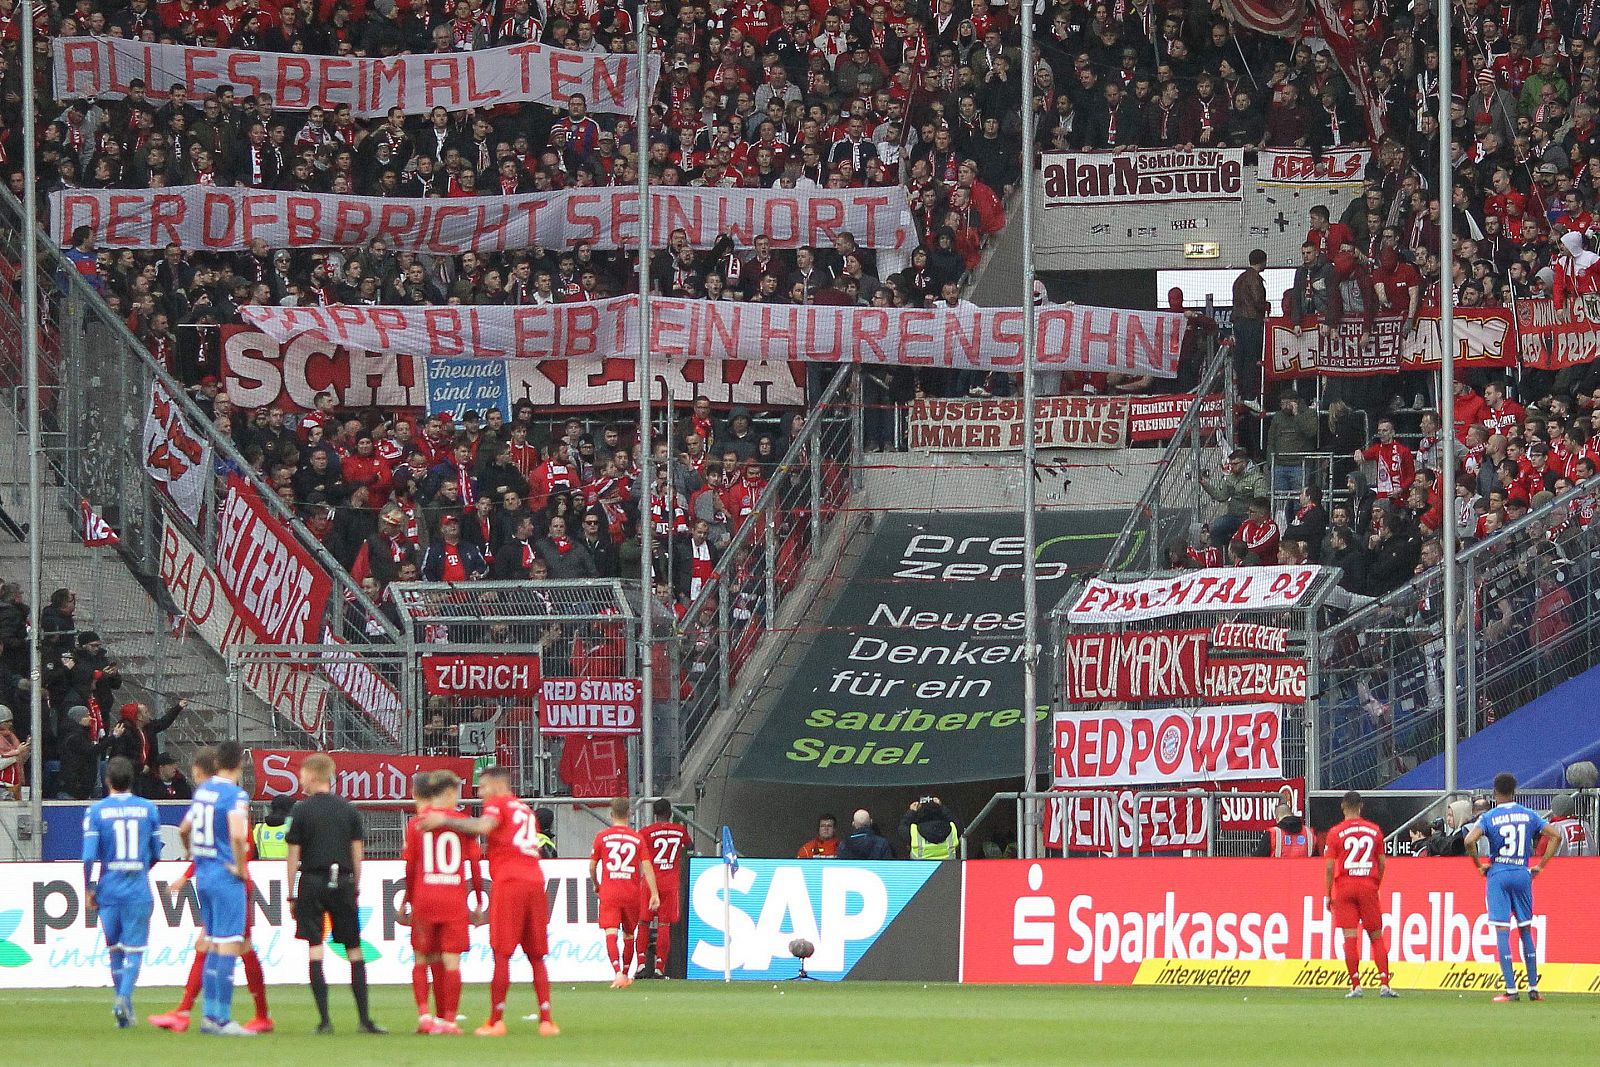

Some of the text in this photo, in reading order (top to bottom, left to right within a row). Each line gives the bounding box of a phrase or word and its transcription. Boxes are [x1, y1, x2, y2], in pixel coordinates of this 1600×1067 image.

[64, 40, 261, 104] ALLES
[276, 56, 406, 112] BEIM
[62, 192, 906, 252] DER DFB BRICHT SEIN WORT,
[425, 298, 638, 358] BLEIBT
[650, 300, 741, 358] EIN
[760, 305, 1183, 372] HURENSOHN!
[225, 331, 805, 408] SCHIKERIA
[430, 358, 502, 379] Freunde
[433, 380, 501, 401] sind nie
[1131, 400, 1174, 415] FREIHEIT
[911, 421, 1120, 447] IMMER BEI UNS
[1132, 417, 1181, 432] FREUNDE
[161, 526, 215, 626] BAD
[893, 560, 1067, 581] zero
[868, 603, 1026, 631] Neues
[1213, 623, 1288, 652] LETZTE REIHE
[435, 660, 528, 690] ZÜRICH
[1066, 634, 1205, 698] NEUMARKT
[1204, 663, 1305, 697] HARZBURG
[543, 681, 635, 701] RED STARS
[828, 670, 992, 698] für ein
[546, 705, 636, 726] UNITED
[805, 704, 1050, 732] sauberes
[470, 729, 486, 744] G1
[1054, 711, 1280, 777] RED POWER
[786, 738, 930, 768] Spiel.
[1049, 788, 1208, 846] WEINSFELD
[113, 819, 139, 860] 11
[422, 831, 461, 874] 10
[653, 838, 681, 864] 27
[1344, 835, 1373, 869] 22
[1499, 823, 1526, 857] 31
[605, 841, 636, 873] 32
[691, 866, 888, 971] SAP
[1066, 889, 1546, 981] Sparkasse Hdelbeg
[1154, 960, 1251, 985] interwetten
